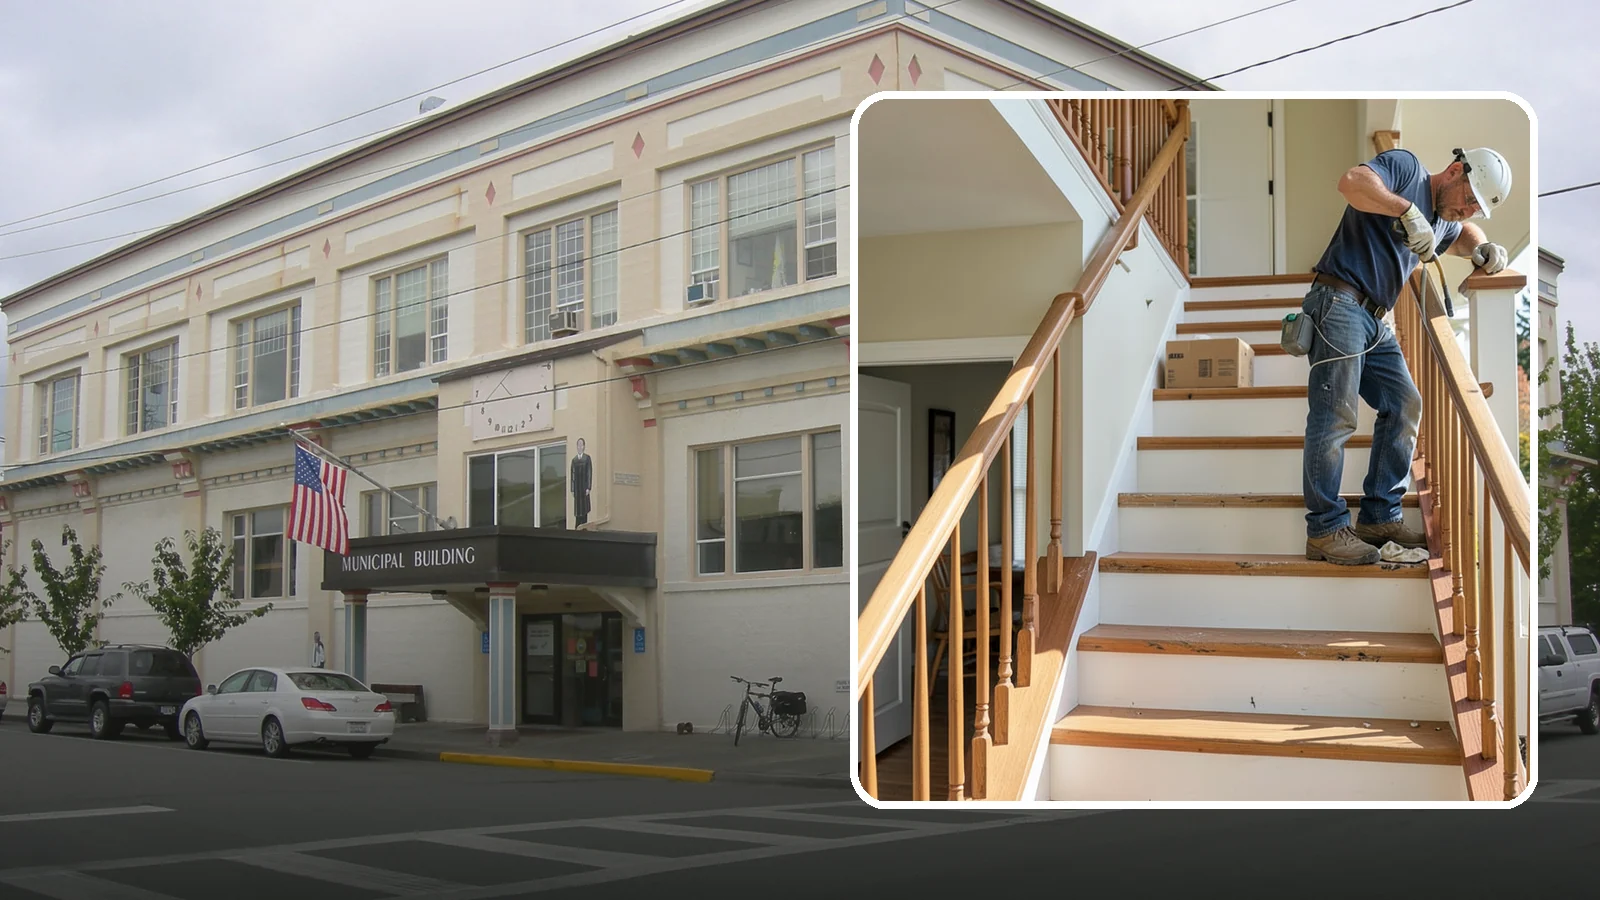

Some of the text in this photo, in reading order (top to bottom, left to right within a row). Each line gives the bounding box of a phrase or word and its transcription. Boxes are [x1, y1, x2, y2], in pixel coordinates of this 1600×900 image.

[494, 423, 501, 432] 10
[520, 419, 526, 429] 2
[341, 546, 475, 572] MUNICIPAL BUILDING
